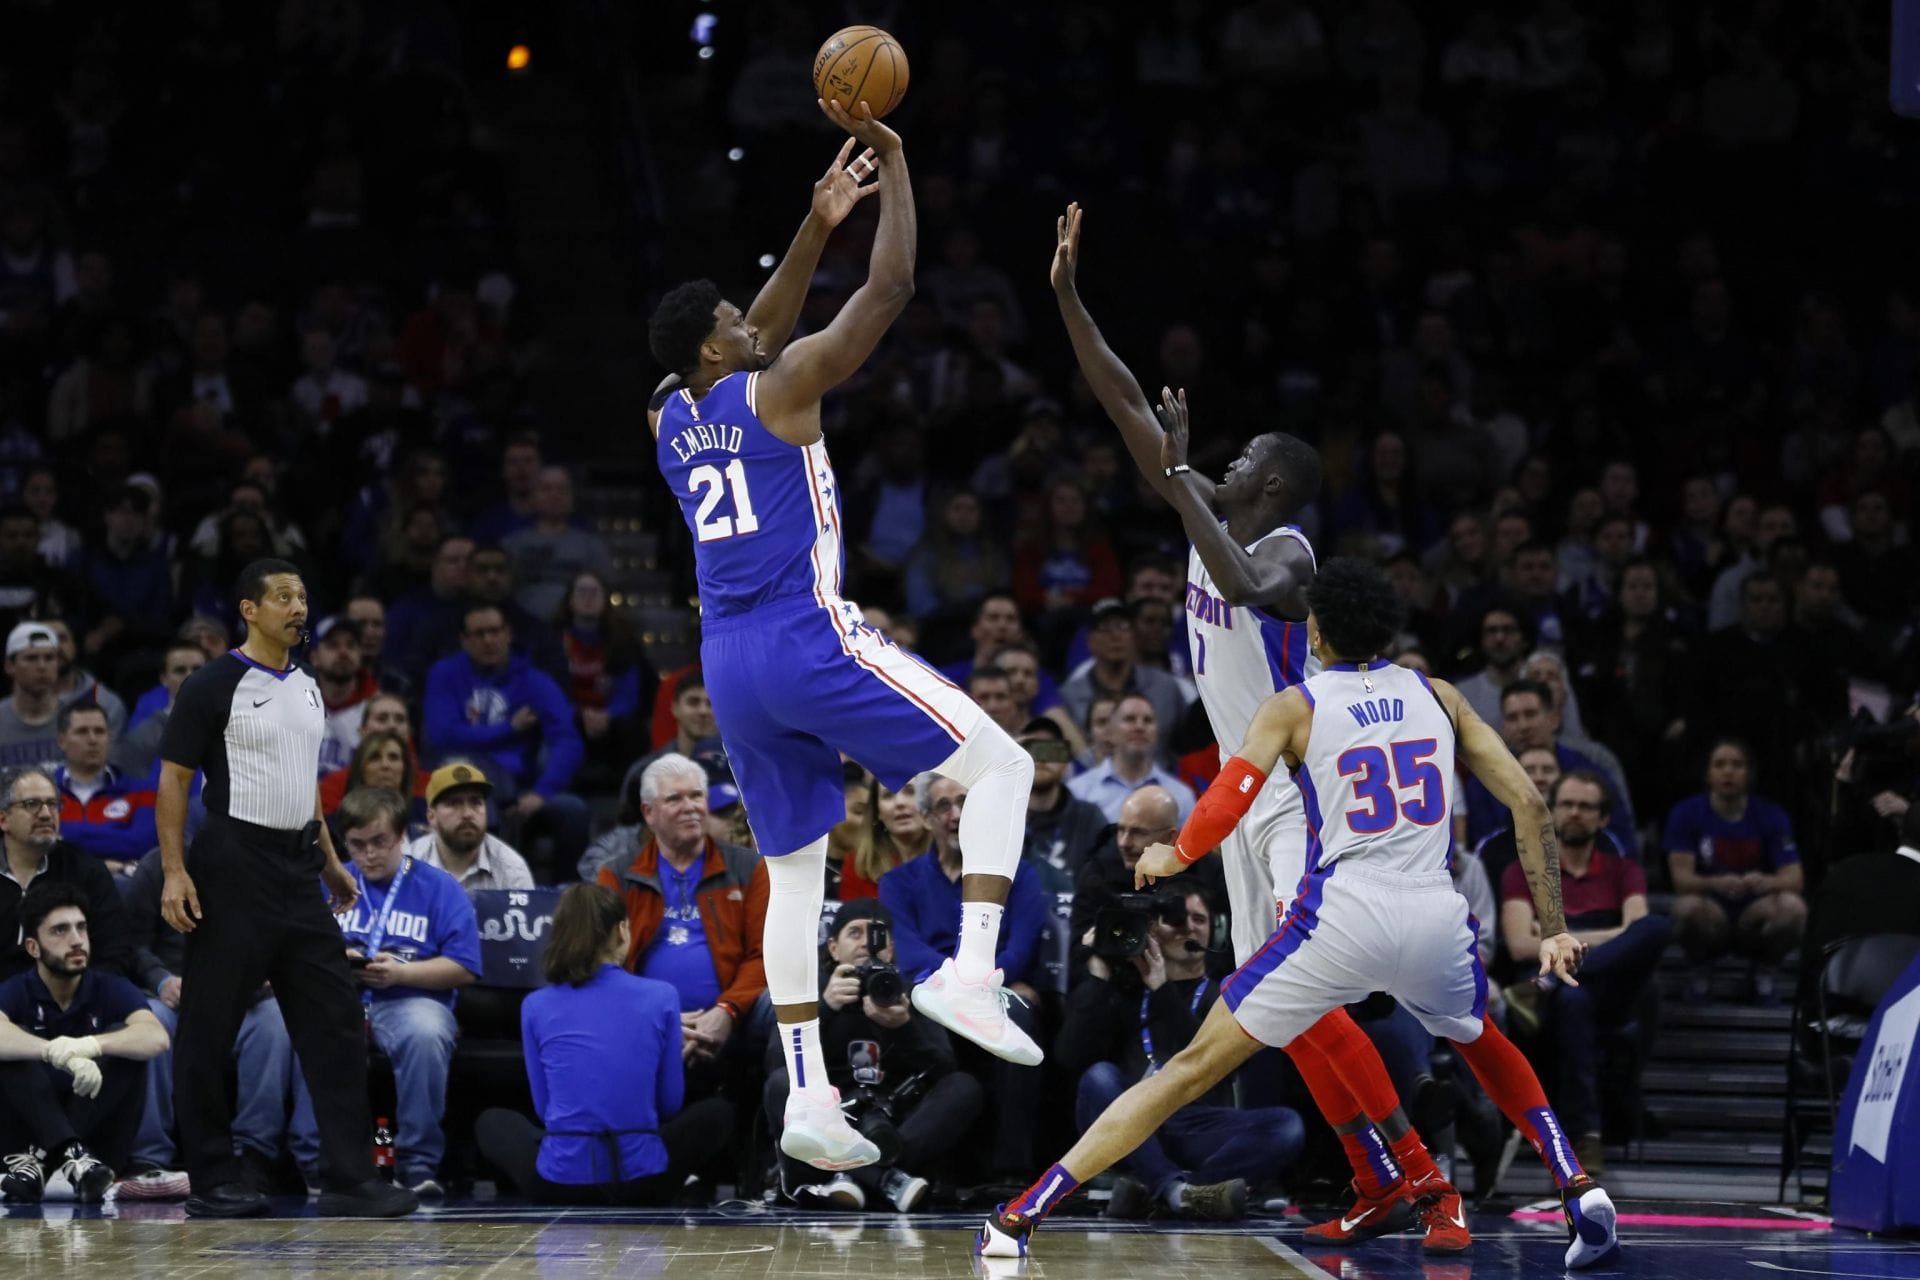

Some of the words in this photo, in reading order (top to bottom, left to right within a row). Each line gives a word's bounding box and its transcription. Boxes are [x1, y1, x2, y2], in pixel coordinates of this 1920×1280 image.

[670, 423, 743, 463] EMBIID
[688, 458, 759, 542] 21
[1347, 698, 1404, 728] WOOD
[1337, 738, 1446, 834] 35
[333, 908, 429, 943] RLNDO
